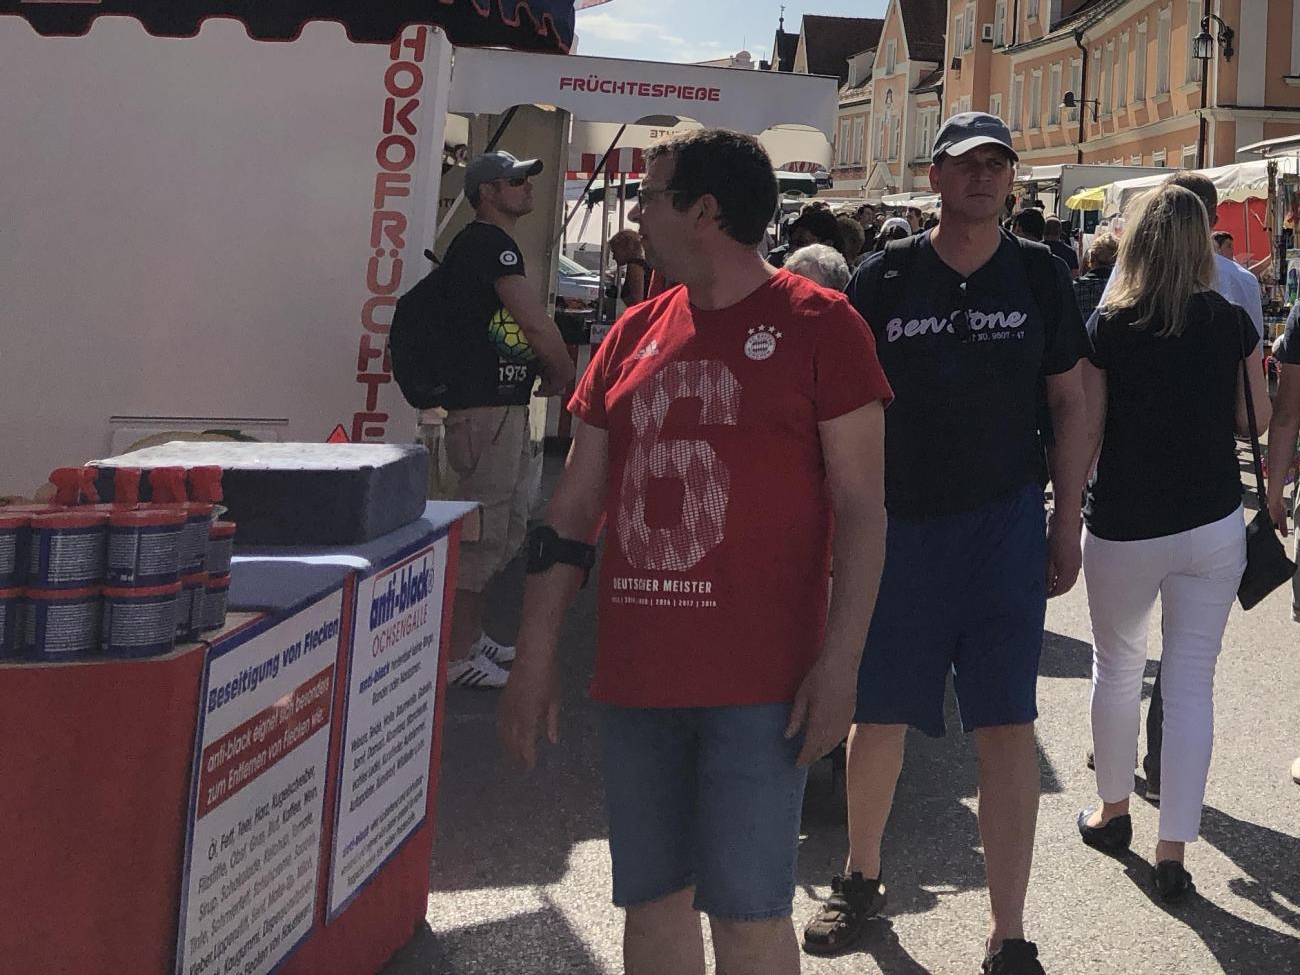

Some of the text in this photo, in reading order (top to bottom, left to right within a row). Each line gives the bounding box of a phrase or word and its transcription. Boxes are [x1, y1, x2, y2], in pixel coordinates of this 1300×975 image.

[499, 365, 527, 381] 1975
[617, 360, 743, 571] 6
[663, 579, 712, 593] MEISTER
[372, 602, 428, 658] OCHSENGALLE
[208, 617, 338, 713] Beseitigung von Flecken
[207, 726, 252, 773] anti-black
[253, 710, 278, 742] eignet
[207, 780, 227, 805] zum
[228, 750, 267, 787] Entfernen
[268, 737, 282, 759] von
[282, 716, 310, 752] Flecken
